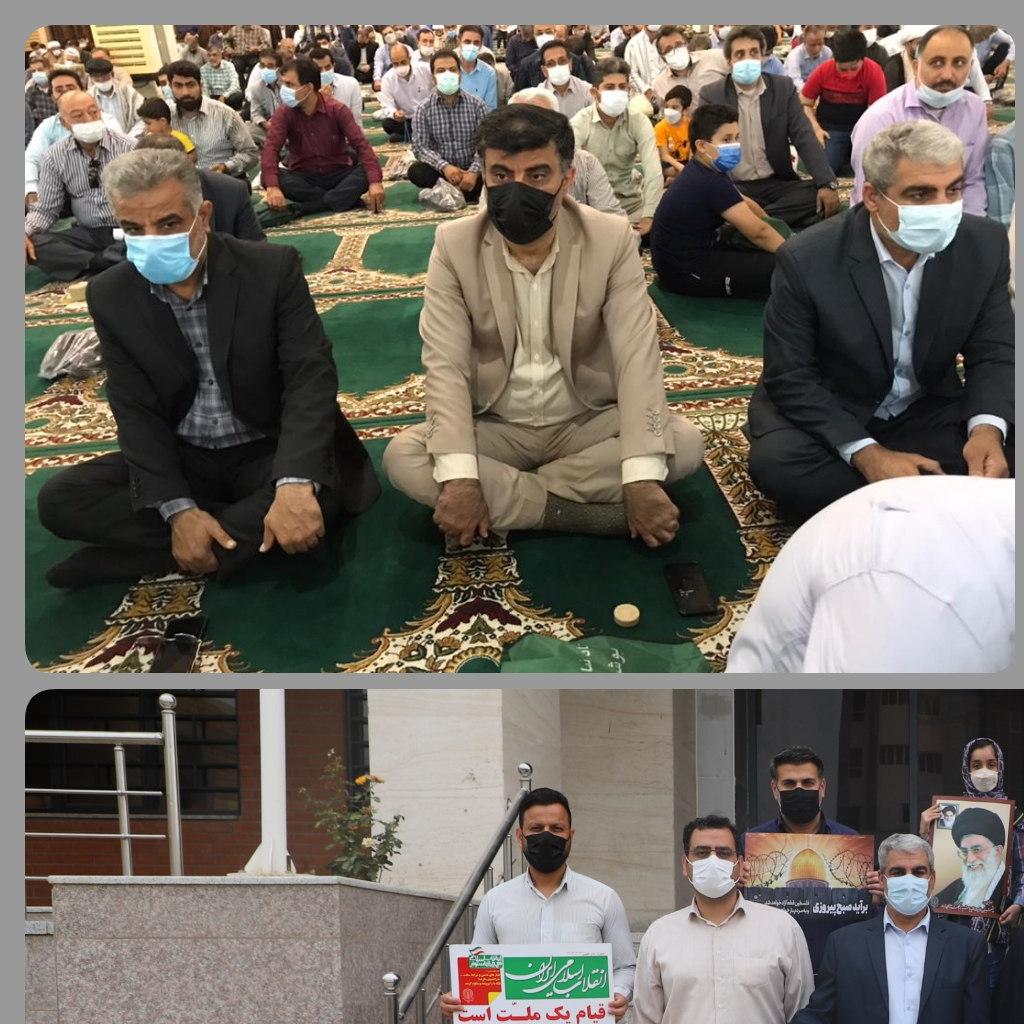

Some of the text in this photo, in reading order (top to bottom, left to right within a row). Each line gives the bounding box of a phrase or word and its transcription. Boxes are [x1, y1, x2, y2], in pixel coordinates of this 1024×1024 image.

[504, 956, 557, 984] ایران
[458, 1007, 491, 1022] است
[545, 1005, 570, 1024] یک
[576, 1004, 606, 1024] قیام
